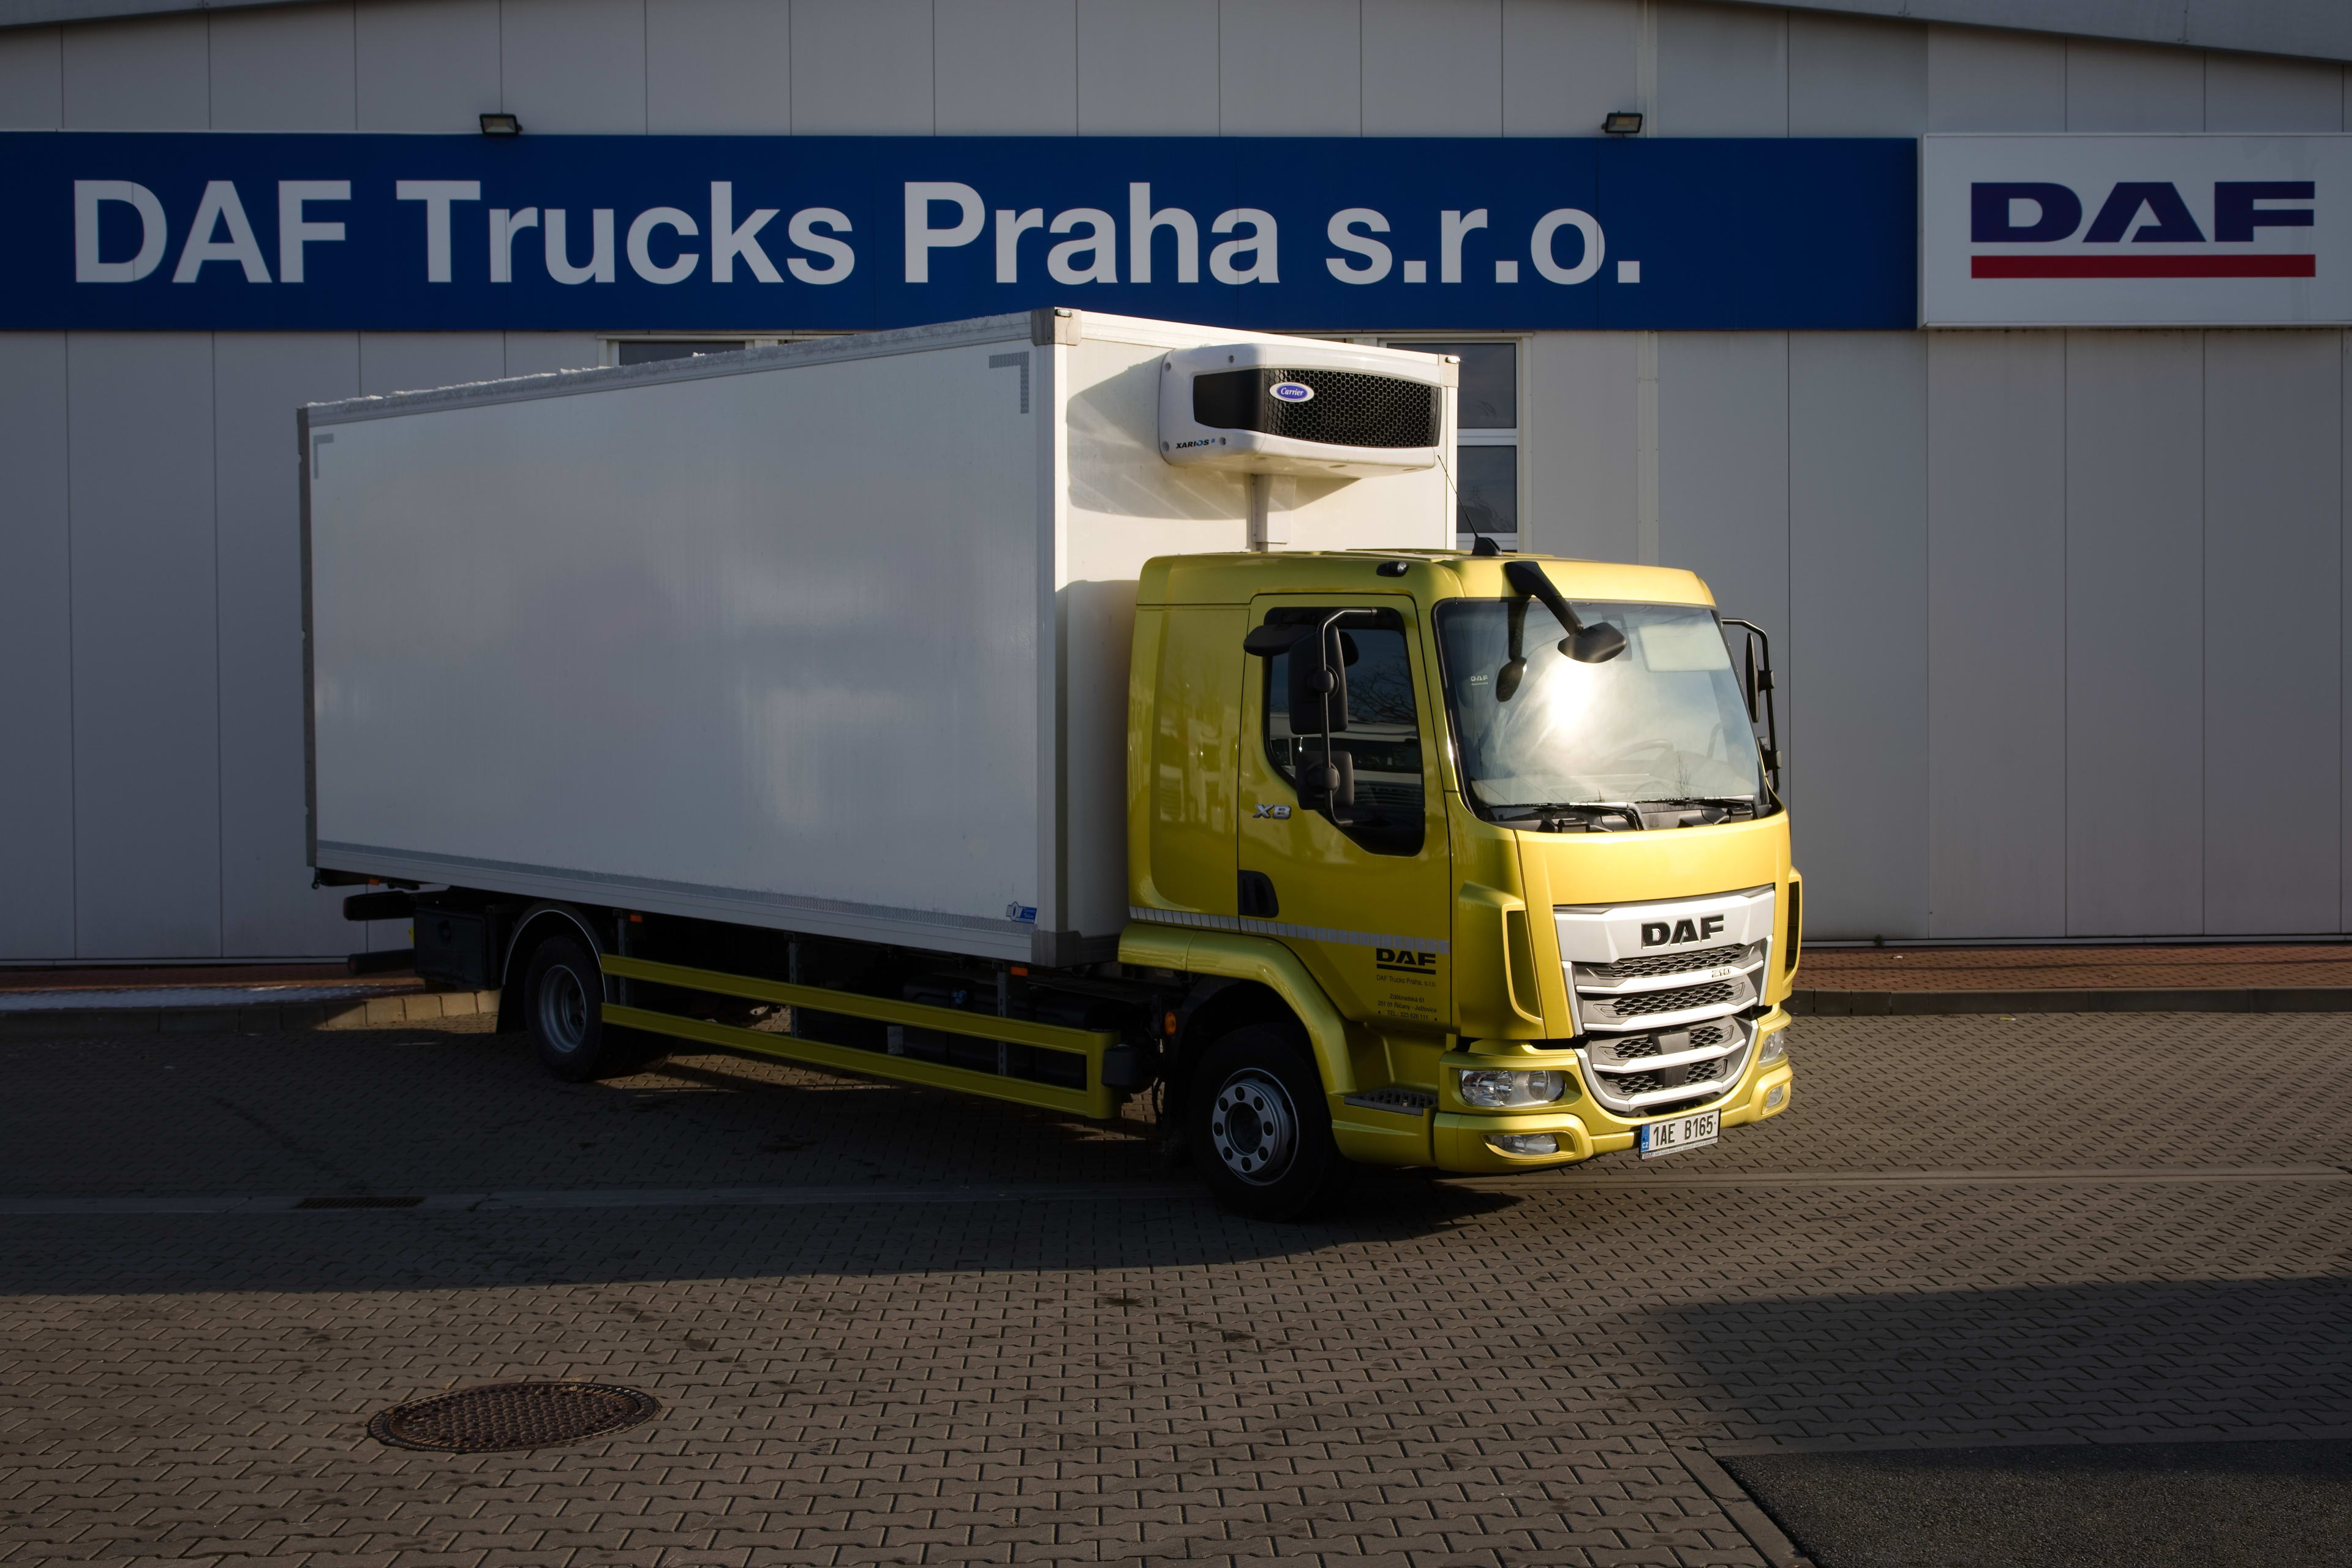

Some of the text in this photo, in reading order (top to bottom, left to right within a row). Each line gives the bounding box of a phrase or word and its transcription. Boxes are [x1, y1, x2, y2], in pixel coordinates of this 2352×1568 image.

[1971, 181, 2315, 243] DAF
[74, 180, 1640, 285] DAF Trucks Praha s.r.o.
[1281, 387, 1304, 396] Carrier
[1176, 439, 1210, 449] XARIOS
[1253, 804, 1292, 820] XB
[1642, 914, 1724, 949] DAF
[1376, 948, 1436, 966] DAF
[1653, 1123, 1676, 1147] 1AE
[1684, 1115, 1713, 1140] B165
